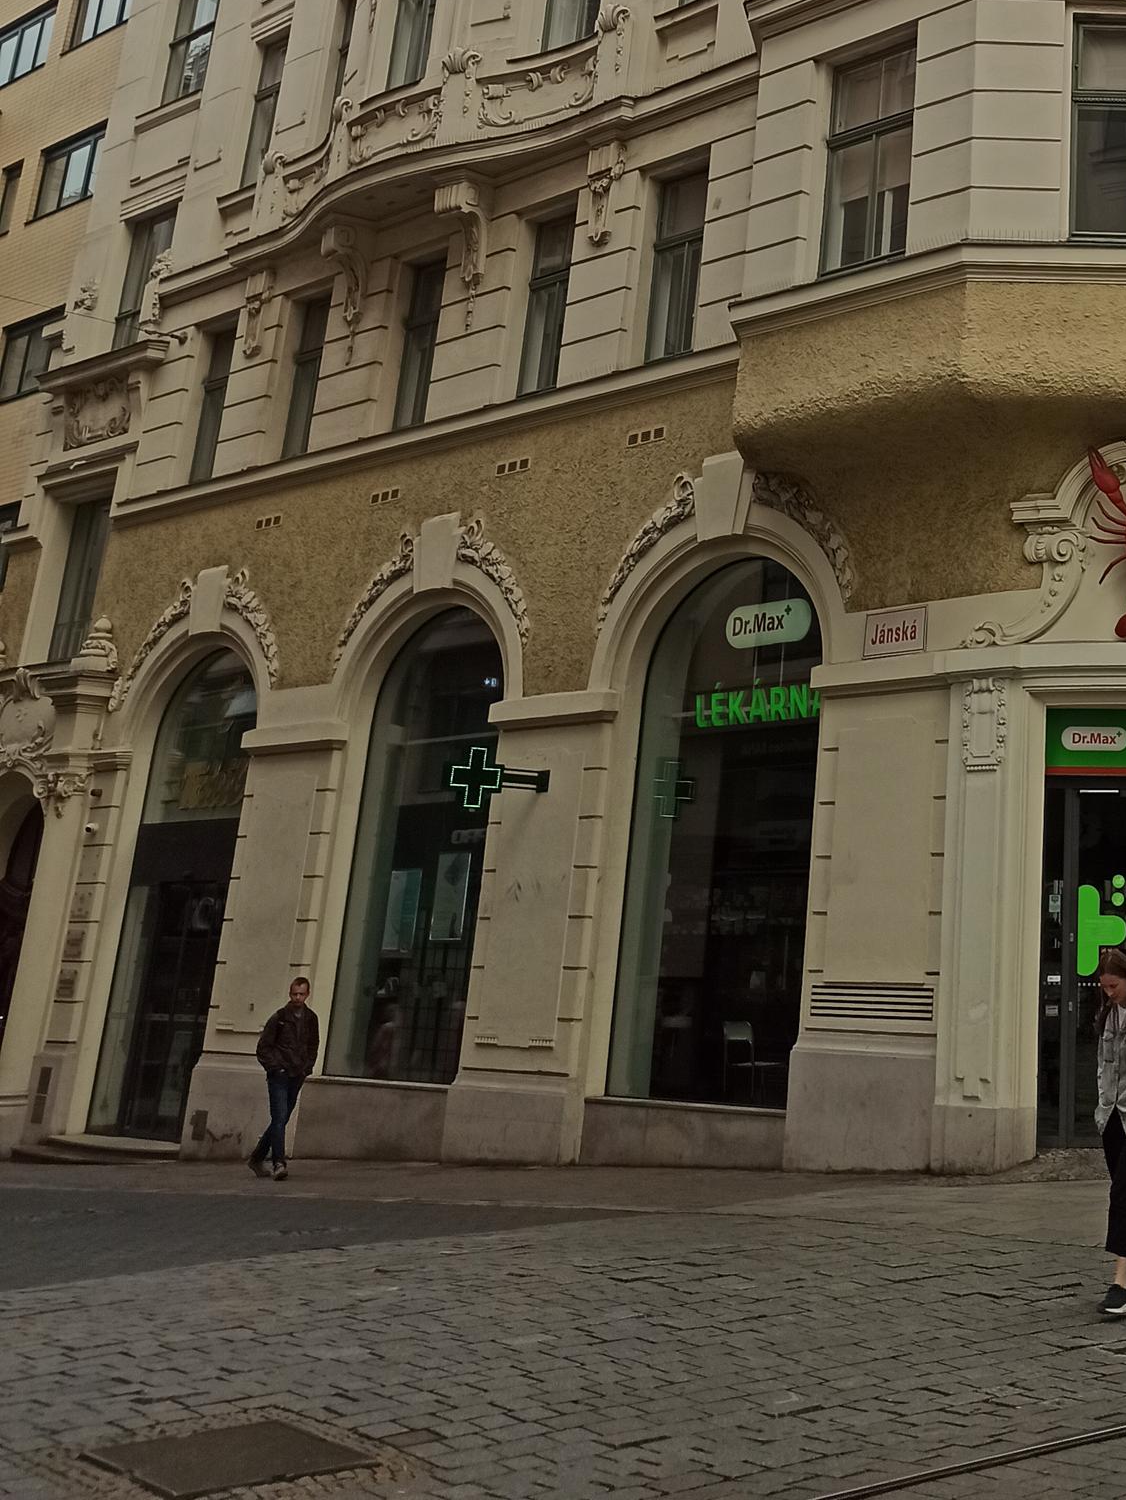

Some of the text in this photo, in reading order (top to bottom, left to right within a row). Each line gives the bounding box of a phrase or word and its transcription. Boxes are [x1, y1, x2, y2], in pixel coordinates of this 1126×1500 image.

[731, 611, 785, 637] Dr.Max
[871, 619, 917, 646] Jánská
[1071, 732, 1117, 745] Dr.Max
